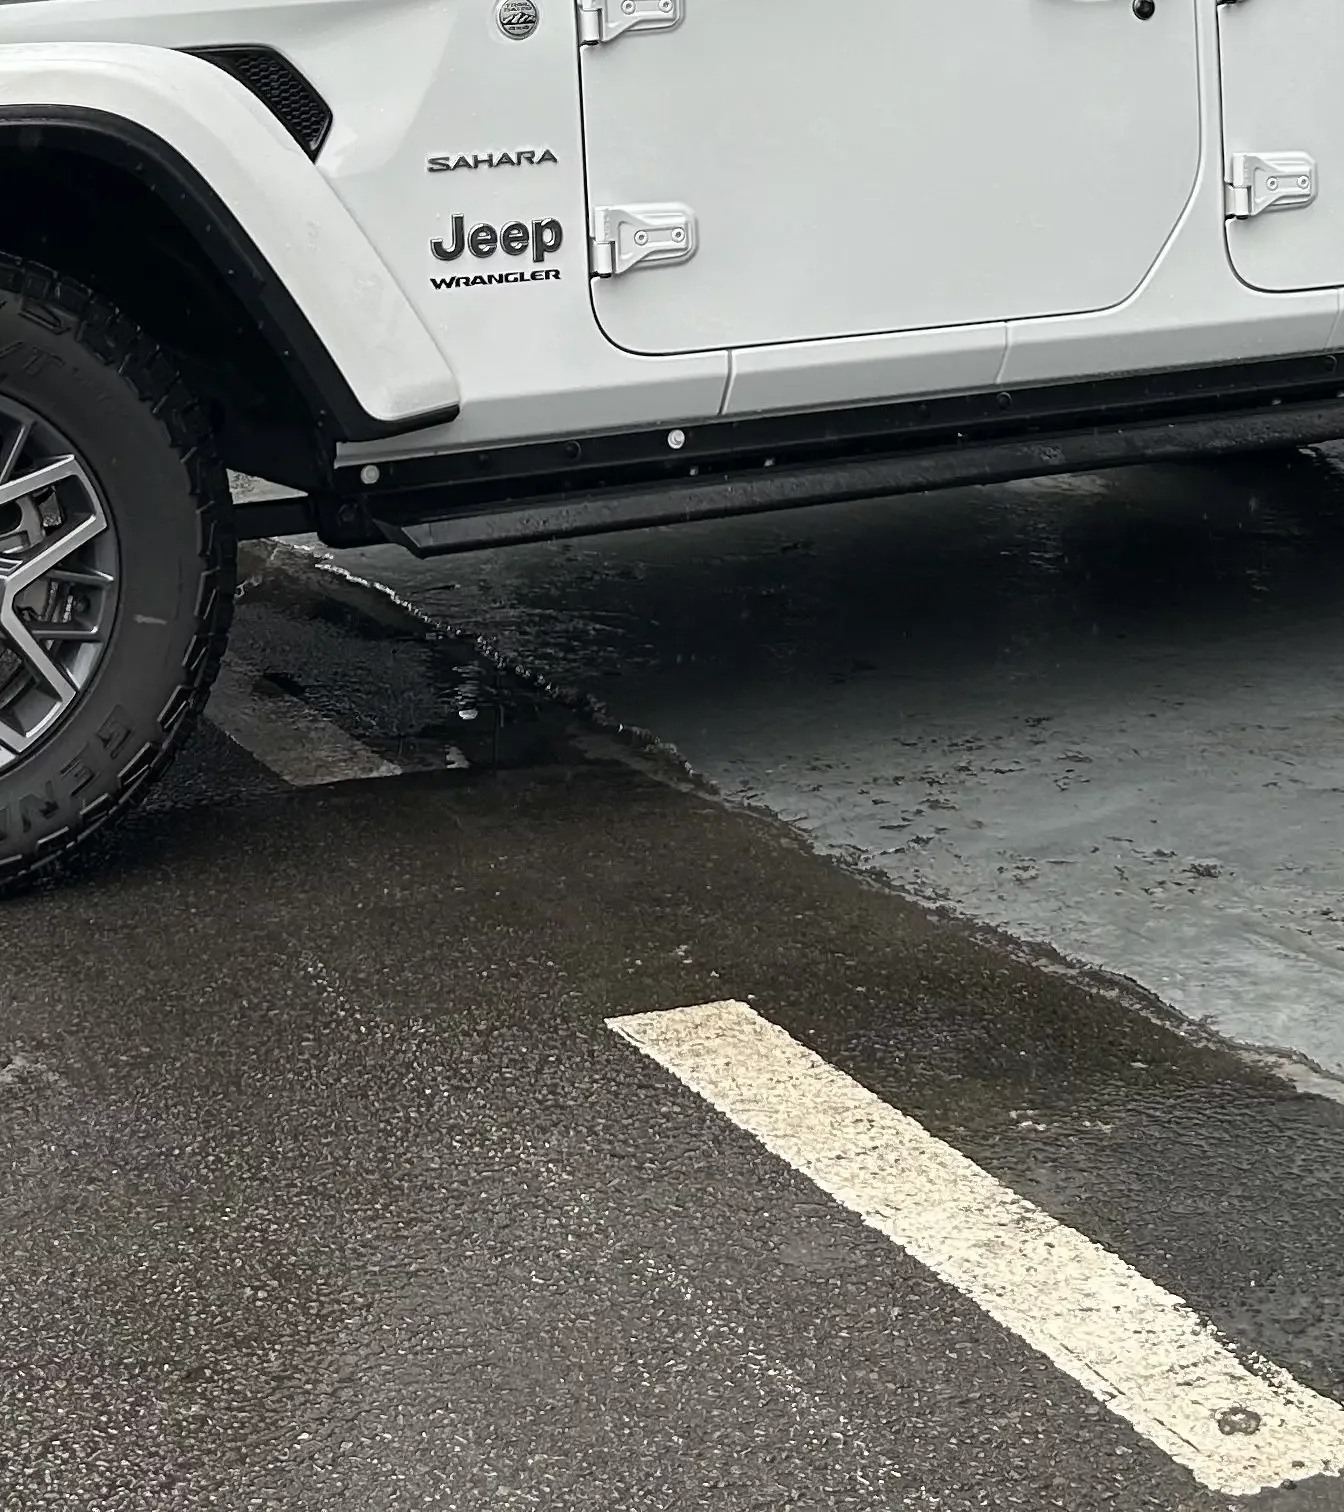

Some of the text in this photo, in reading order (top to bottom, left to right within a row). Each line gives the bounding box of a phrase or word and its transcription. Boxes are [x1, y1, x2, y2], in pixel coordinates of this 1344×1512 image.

[427, 148, 559, 174] SAHARA
[430, 213, 563, 263] Jeep
[430, 268, 562, 291] WRANGLER
